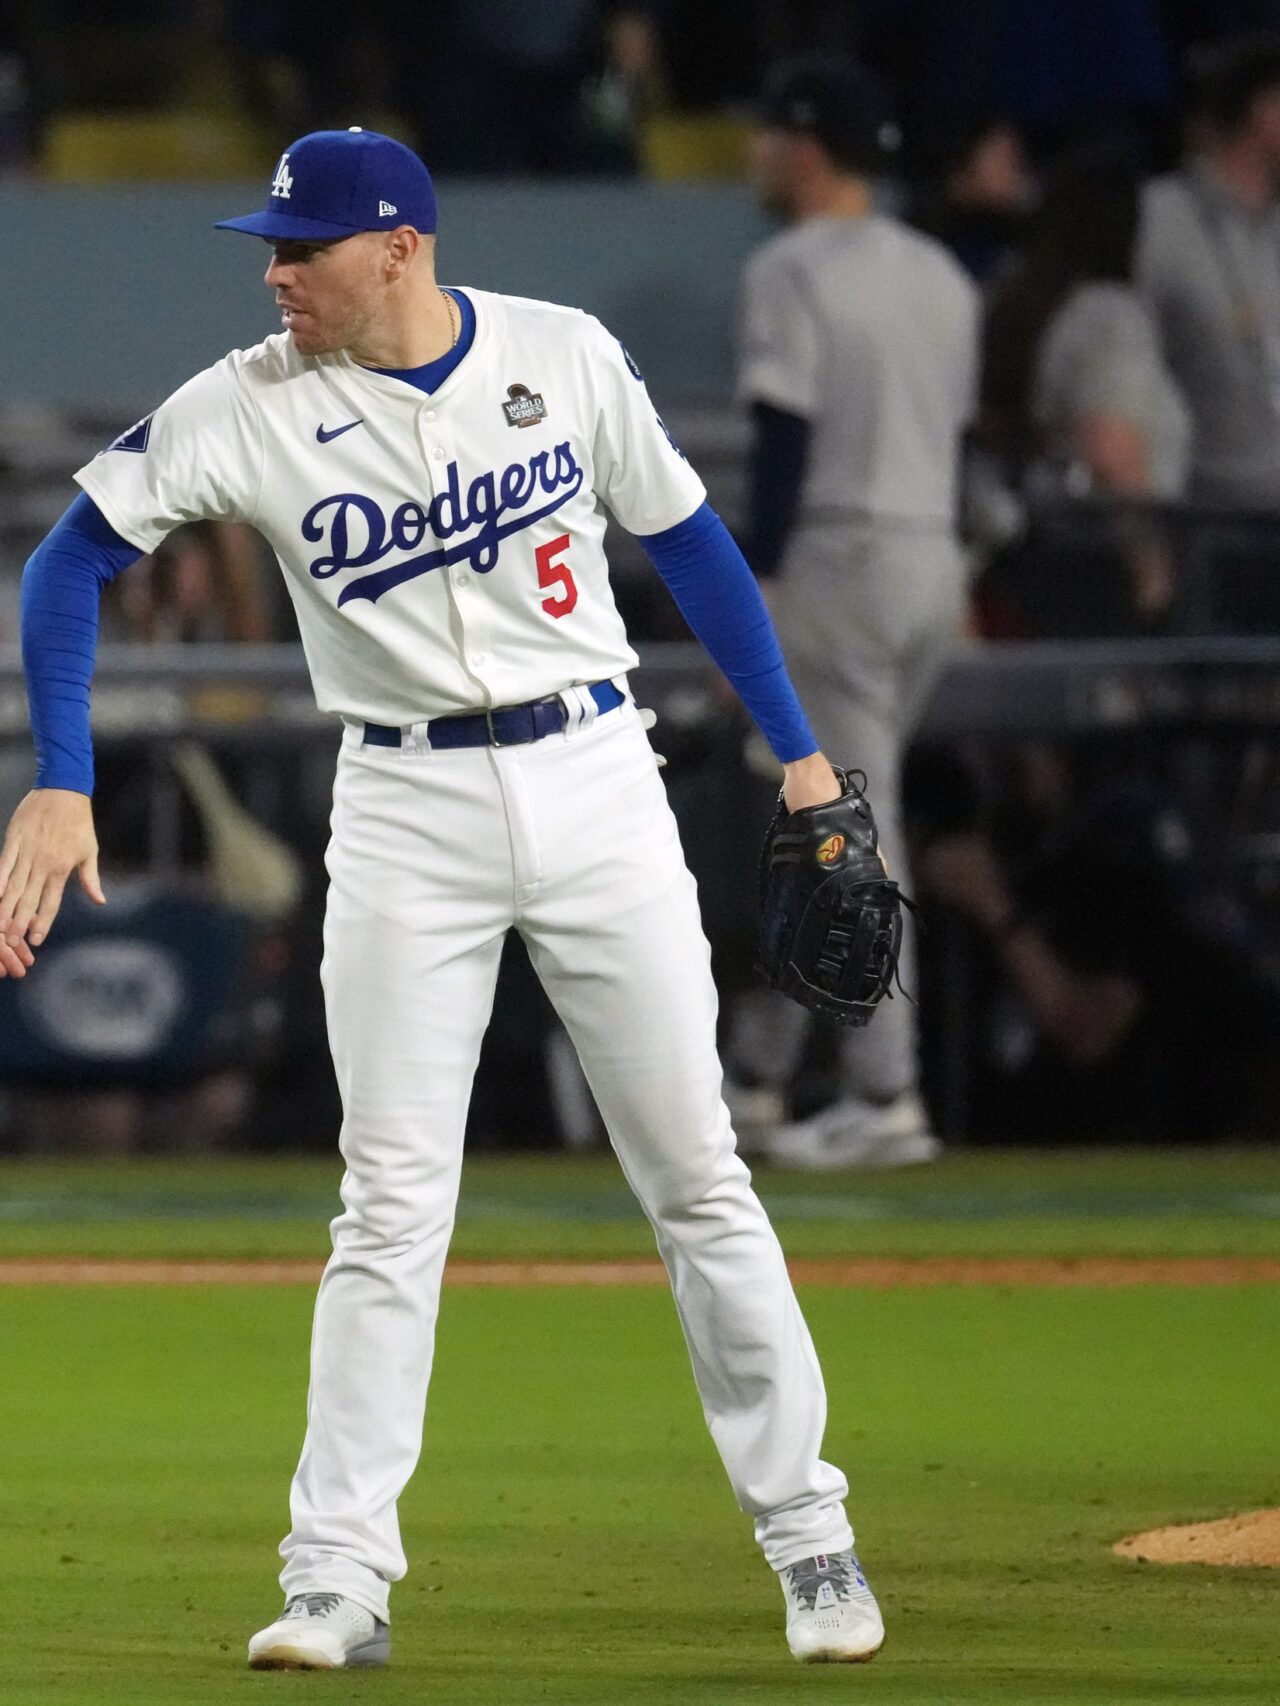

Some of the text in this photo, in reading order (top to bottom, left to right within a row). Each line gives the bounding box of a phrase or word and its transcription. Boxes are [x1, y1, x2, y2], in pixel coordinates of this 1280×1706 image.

[271, 153, 294, 199] LA
[506, 398, 542, 413] WORLD
[510, 406, 544, 420] SERIES
[301, 440, 584, 609] Dodgers
[535, 534, 577, 619] 5
